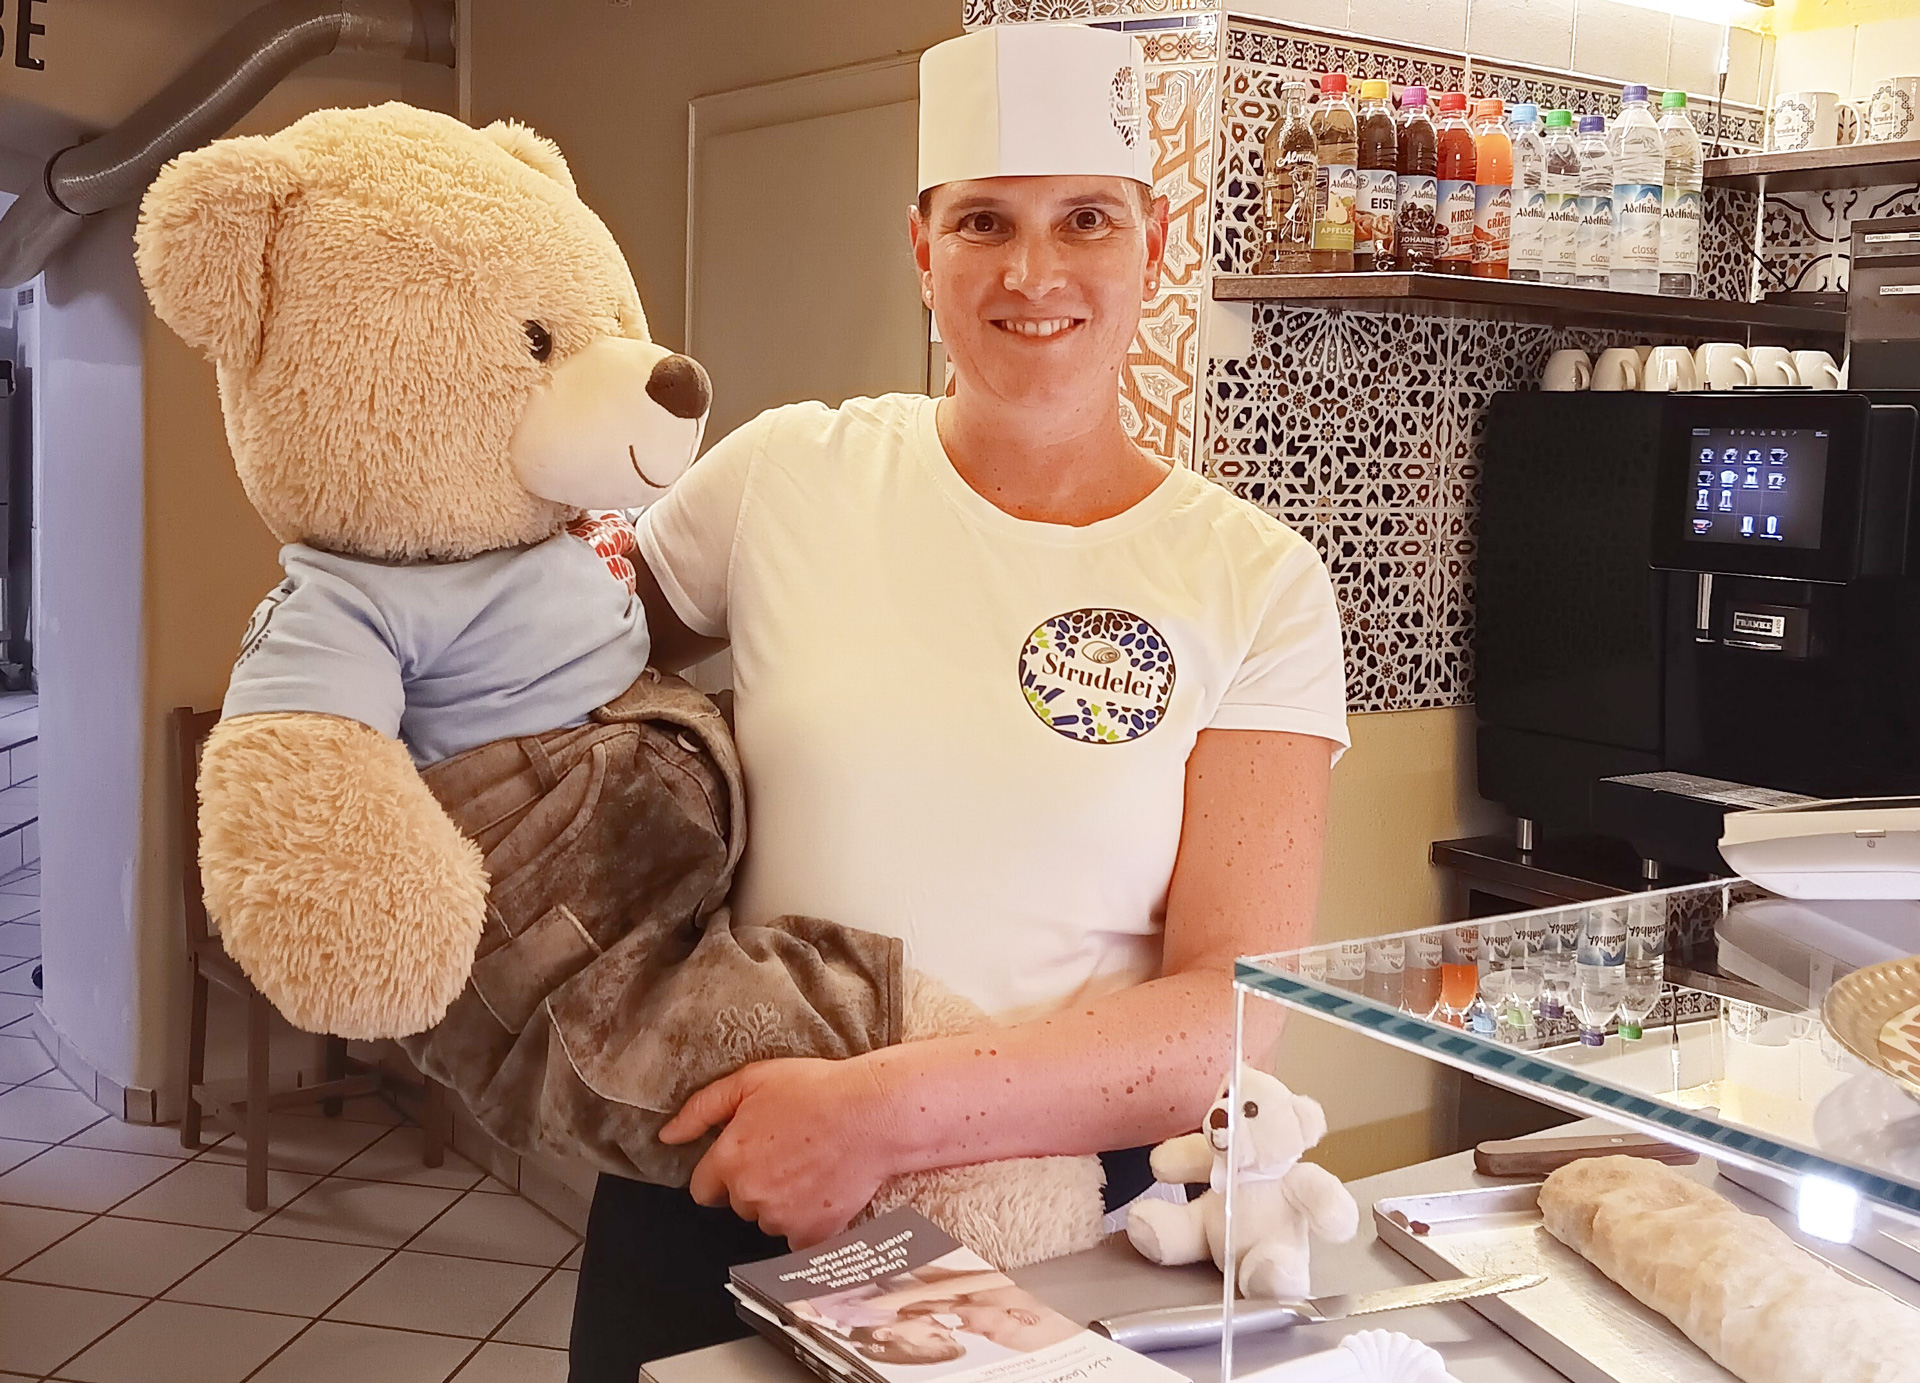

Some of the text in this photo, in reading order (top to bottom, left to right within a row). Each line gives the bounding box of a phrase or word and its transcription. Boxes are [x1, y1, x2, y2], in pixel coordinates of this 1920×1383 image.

[0, 0, 47, 71] E
[1041, 652, 1154, 699] Strudelei
[778, 1230, 913, 1282] einem schwerkranken
[806, 1246, 908, 1284] für Familien mit
[809, 1240, 868, 1267] Elternteil
[826, 1258, 908, 1288] Unser Dienst
